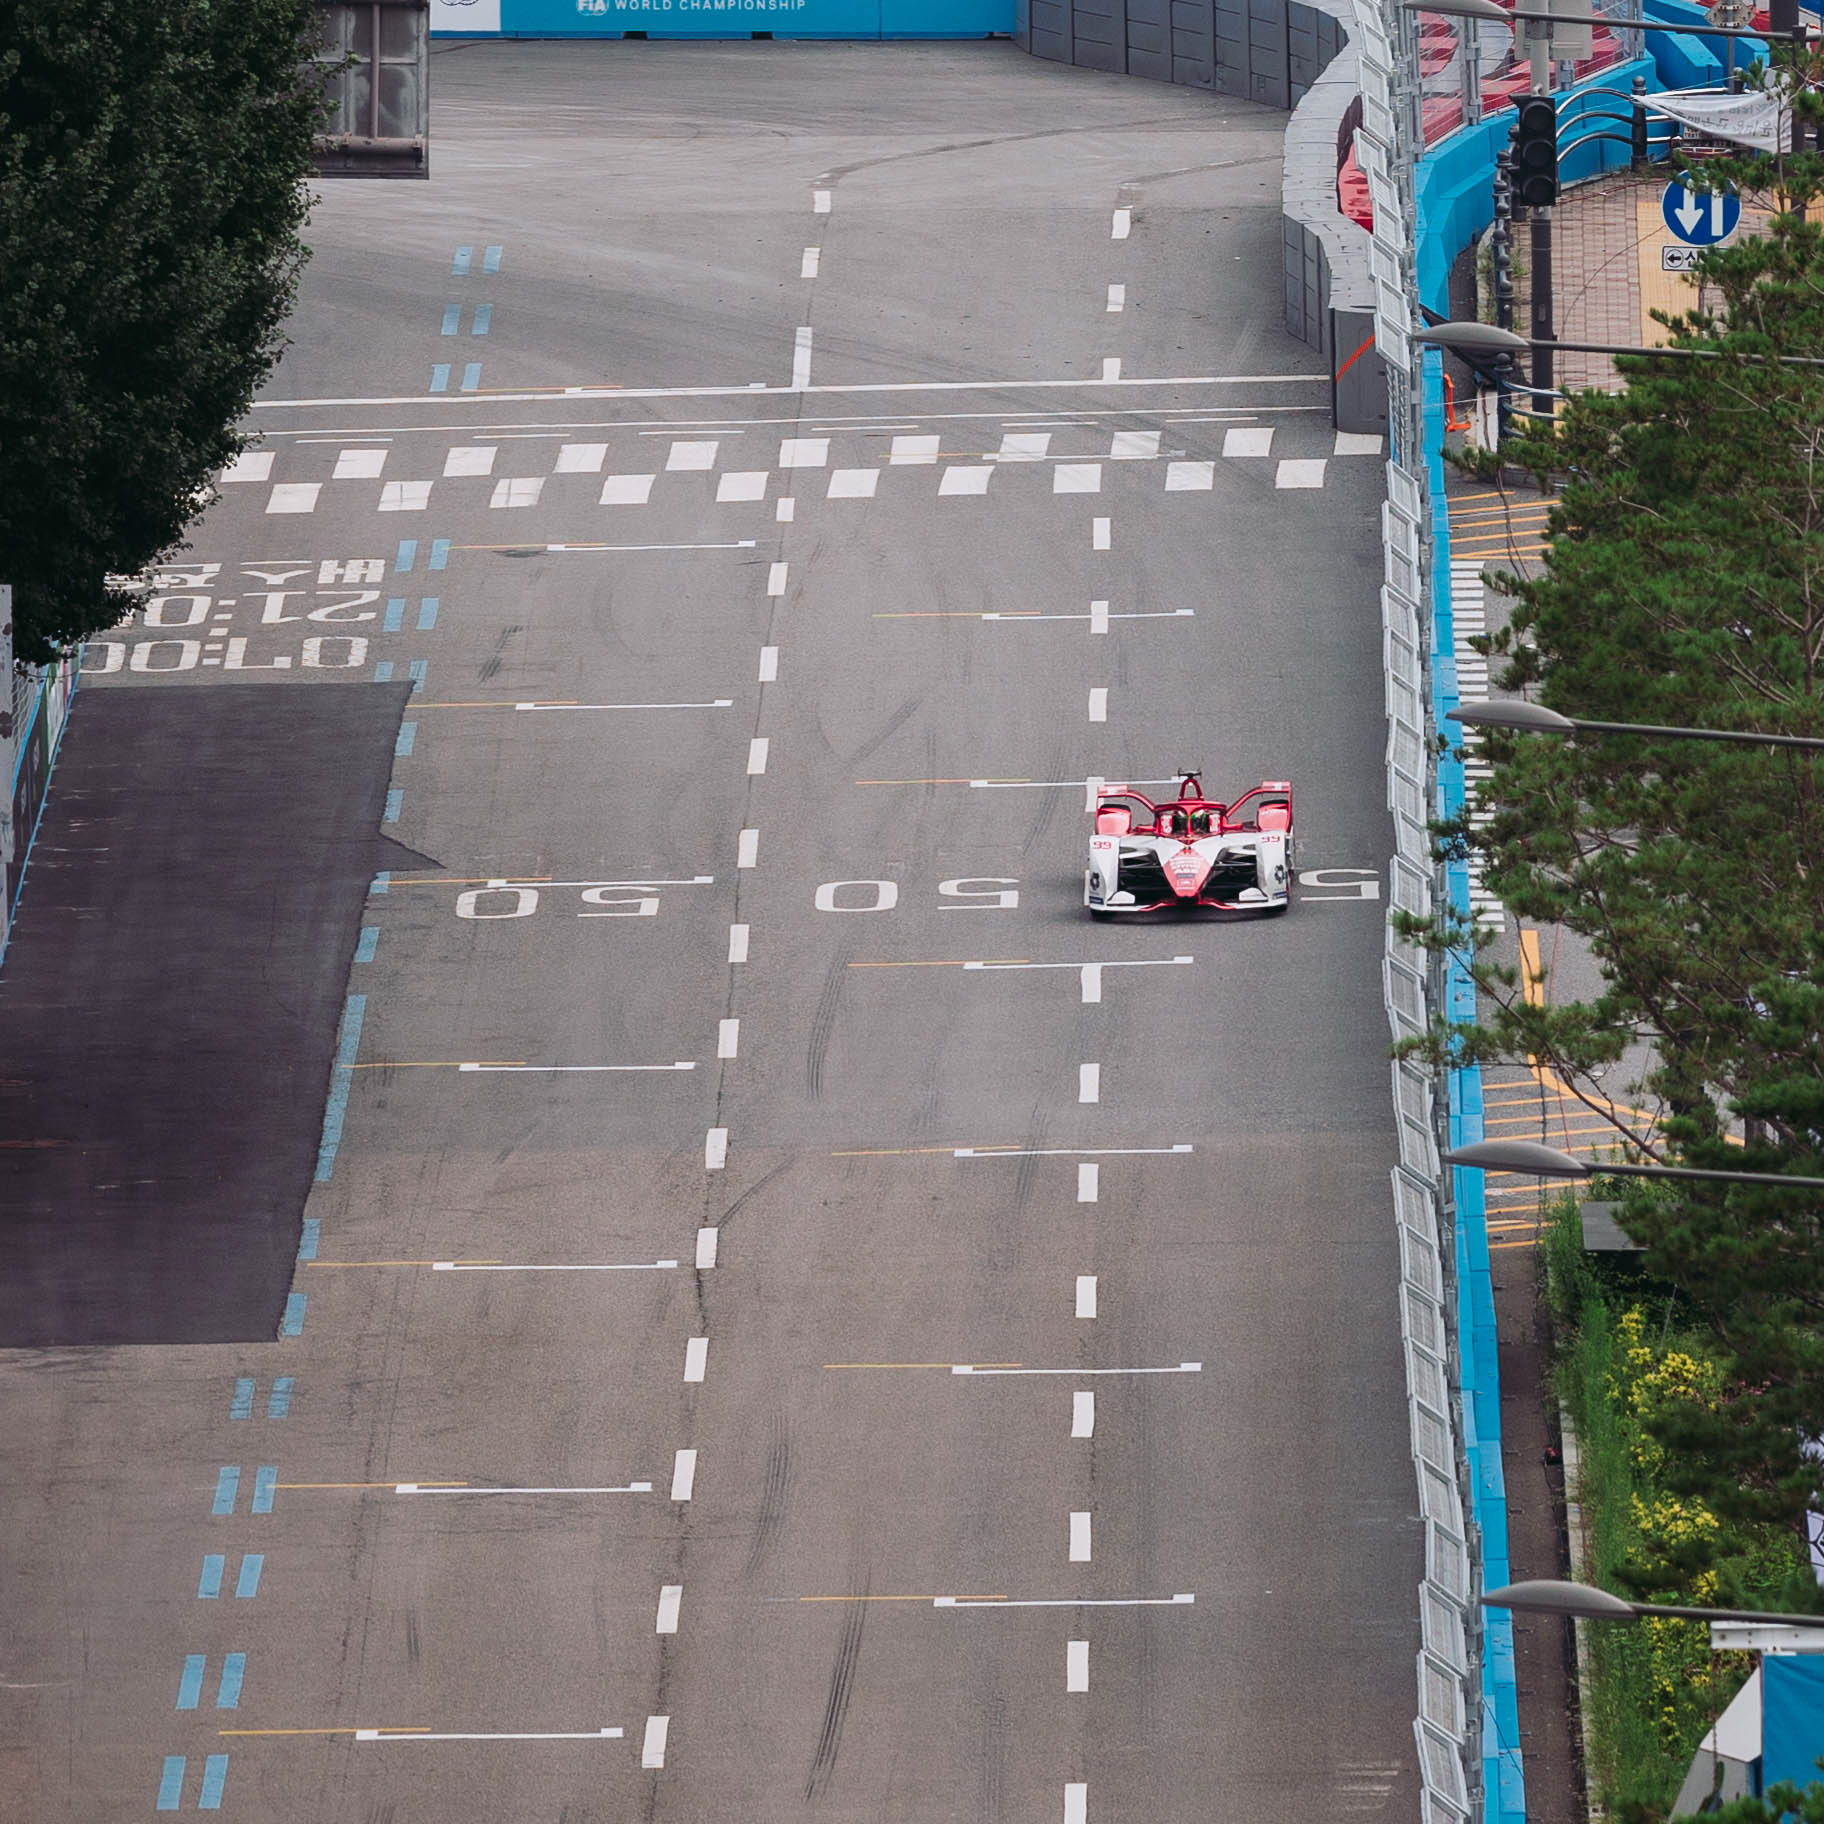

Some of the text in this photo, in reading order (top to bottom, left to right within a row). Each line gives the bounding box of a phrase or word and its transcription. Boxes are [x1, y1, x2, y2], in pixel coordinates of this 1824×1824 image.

[614, 0, 672, 11] WORLD
[679, 0, 806, 11] CHAMPIONSHIP
[1092, 840, 1113, 850] 99
[455, 885, 662, 919] 50
[815, 877, 1020, 912] 50
